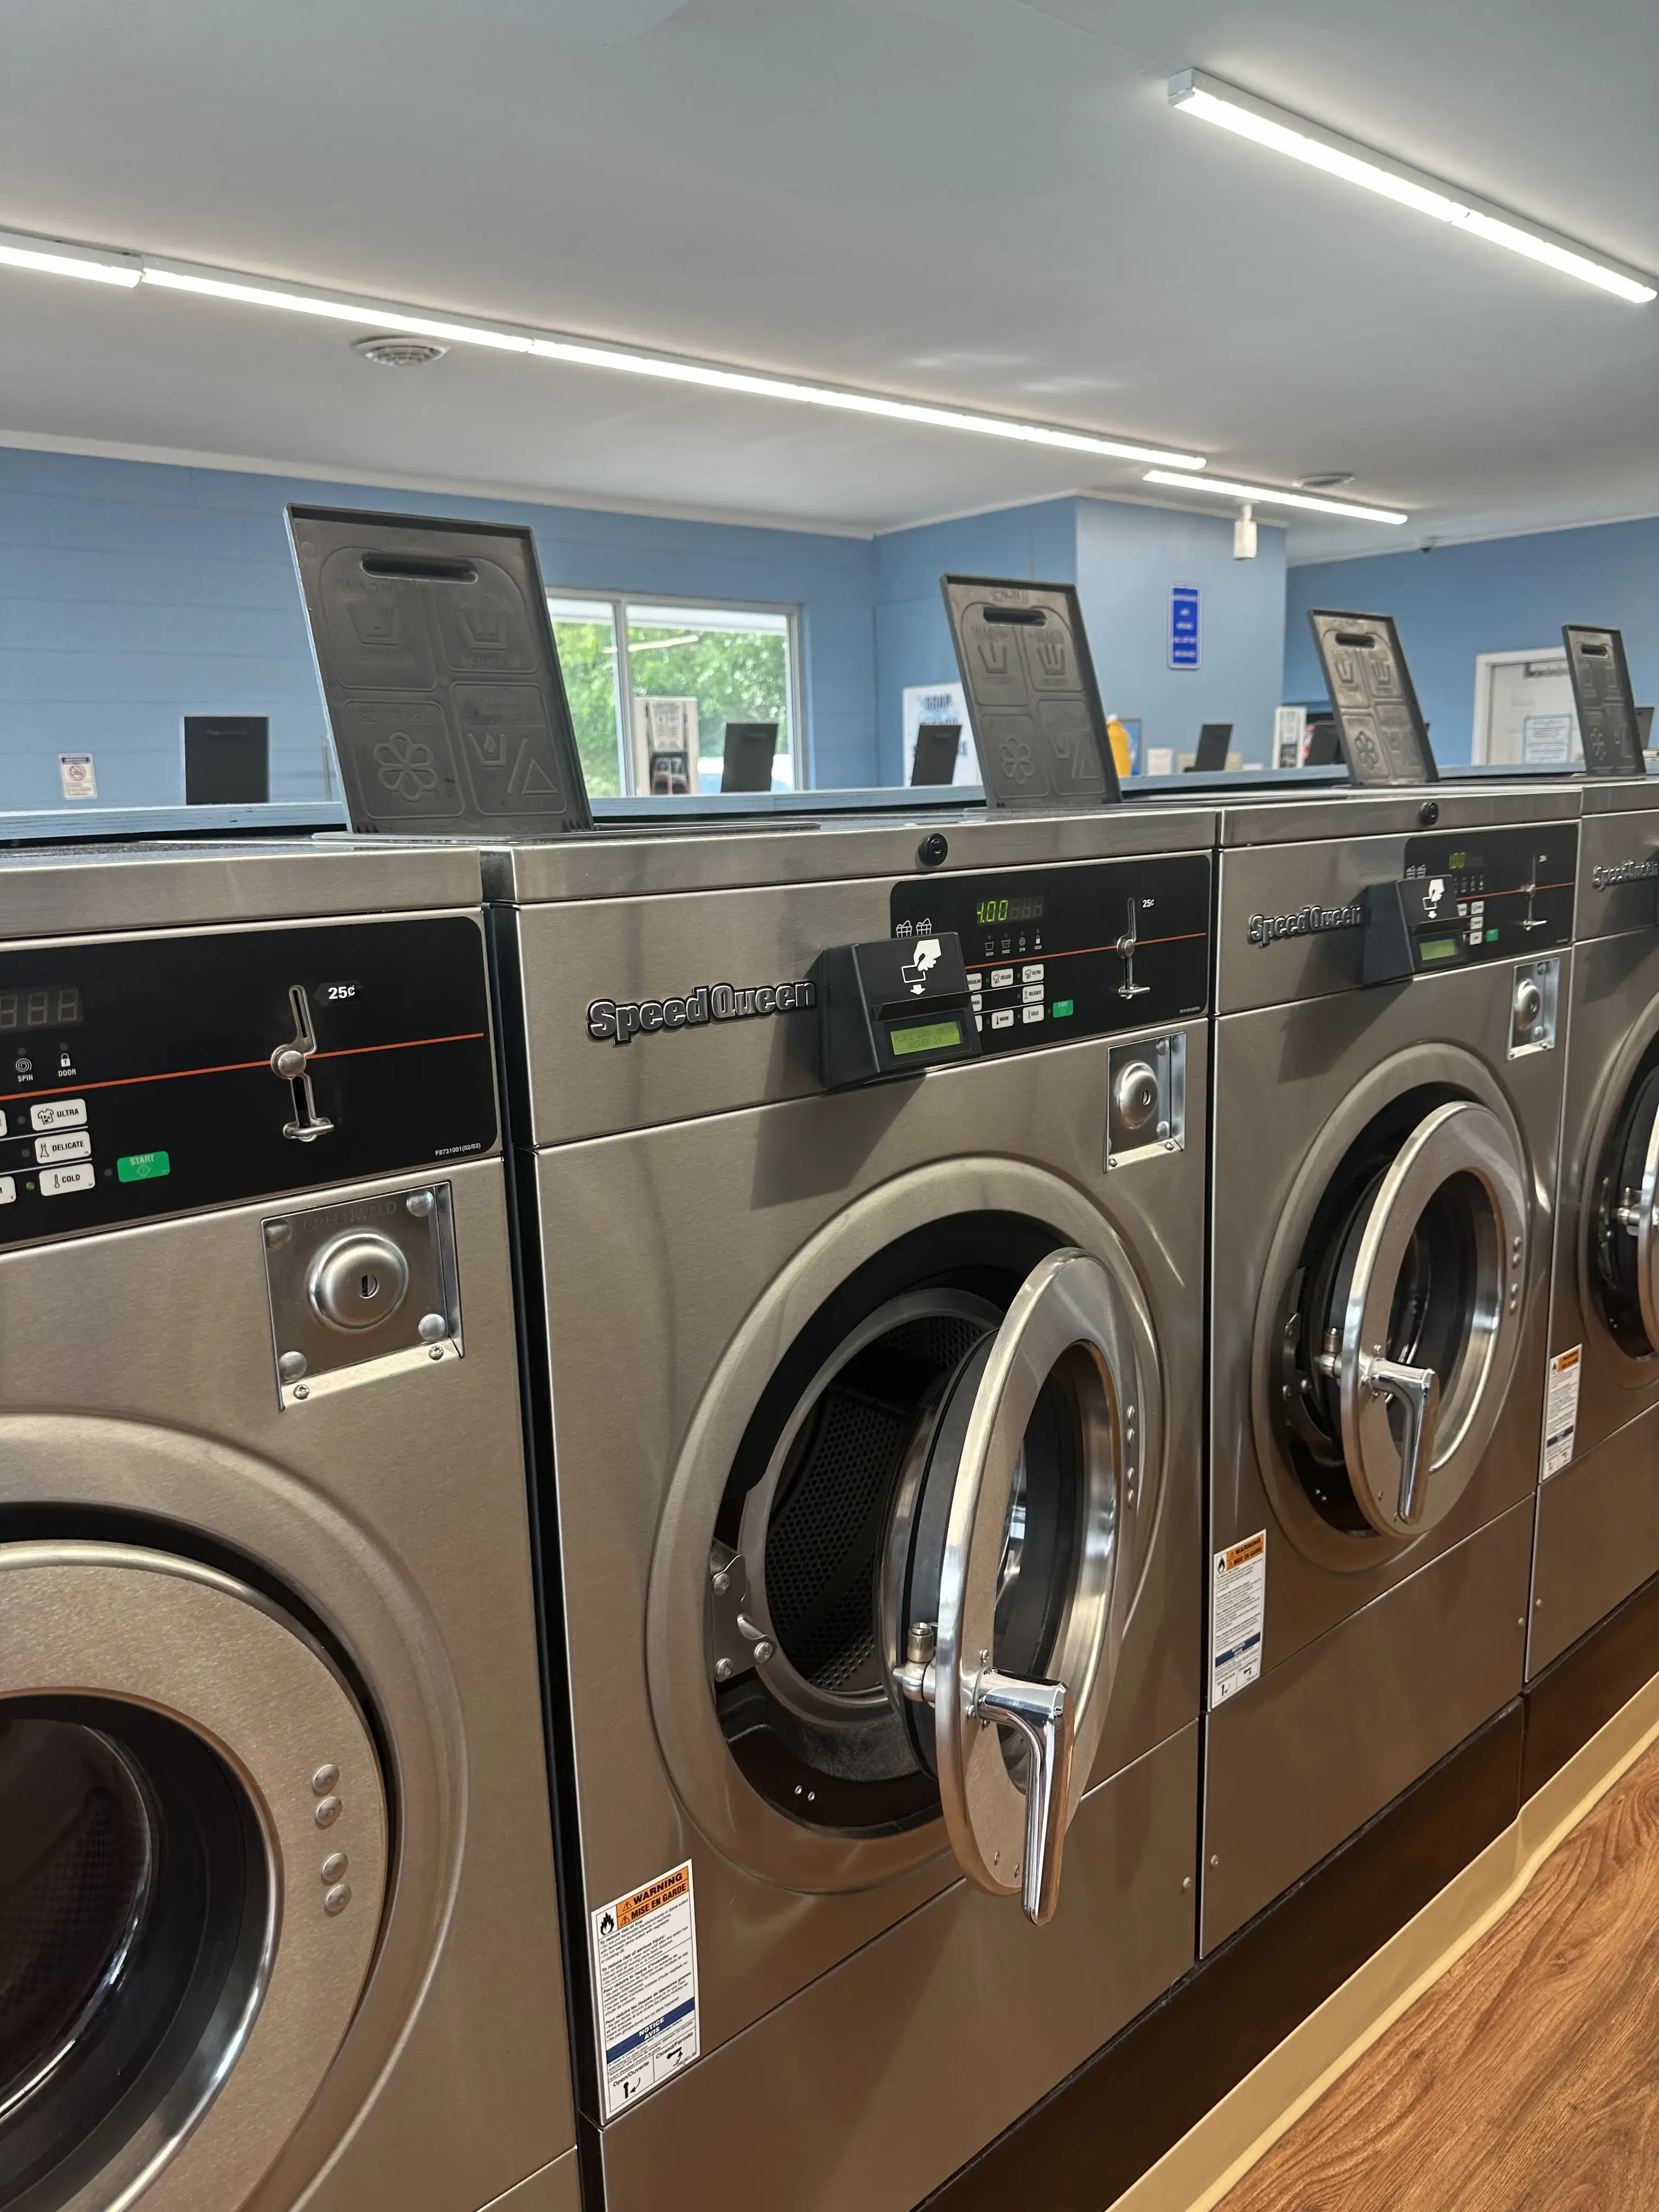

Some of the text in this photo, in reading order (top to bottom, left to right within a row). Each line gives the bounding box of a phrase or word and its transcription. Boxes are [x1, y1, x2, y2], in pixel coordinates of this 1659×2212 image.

[328, 984, 356, 1000] 25¢
[18, 1074, 33, 1082] SPIN
[58, 1069, 77, 1077] DOOR
[57, 1108, 79, 1118] ULTRA
[52, 1141, 84, 1152] DELICATE
[129, 1154, 155, 1166] START
[61, 1174, 80, 1183] COLD
[633, 1872, 682, 1905] WARNING
[631, 1882, 686, 1920] MISE EN GARDE
[639, 2016, 664, 2037] NOTICE
[644, 2025, 660, 2040] AVIS
